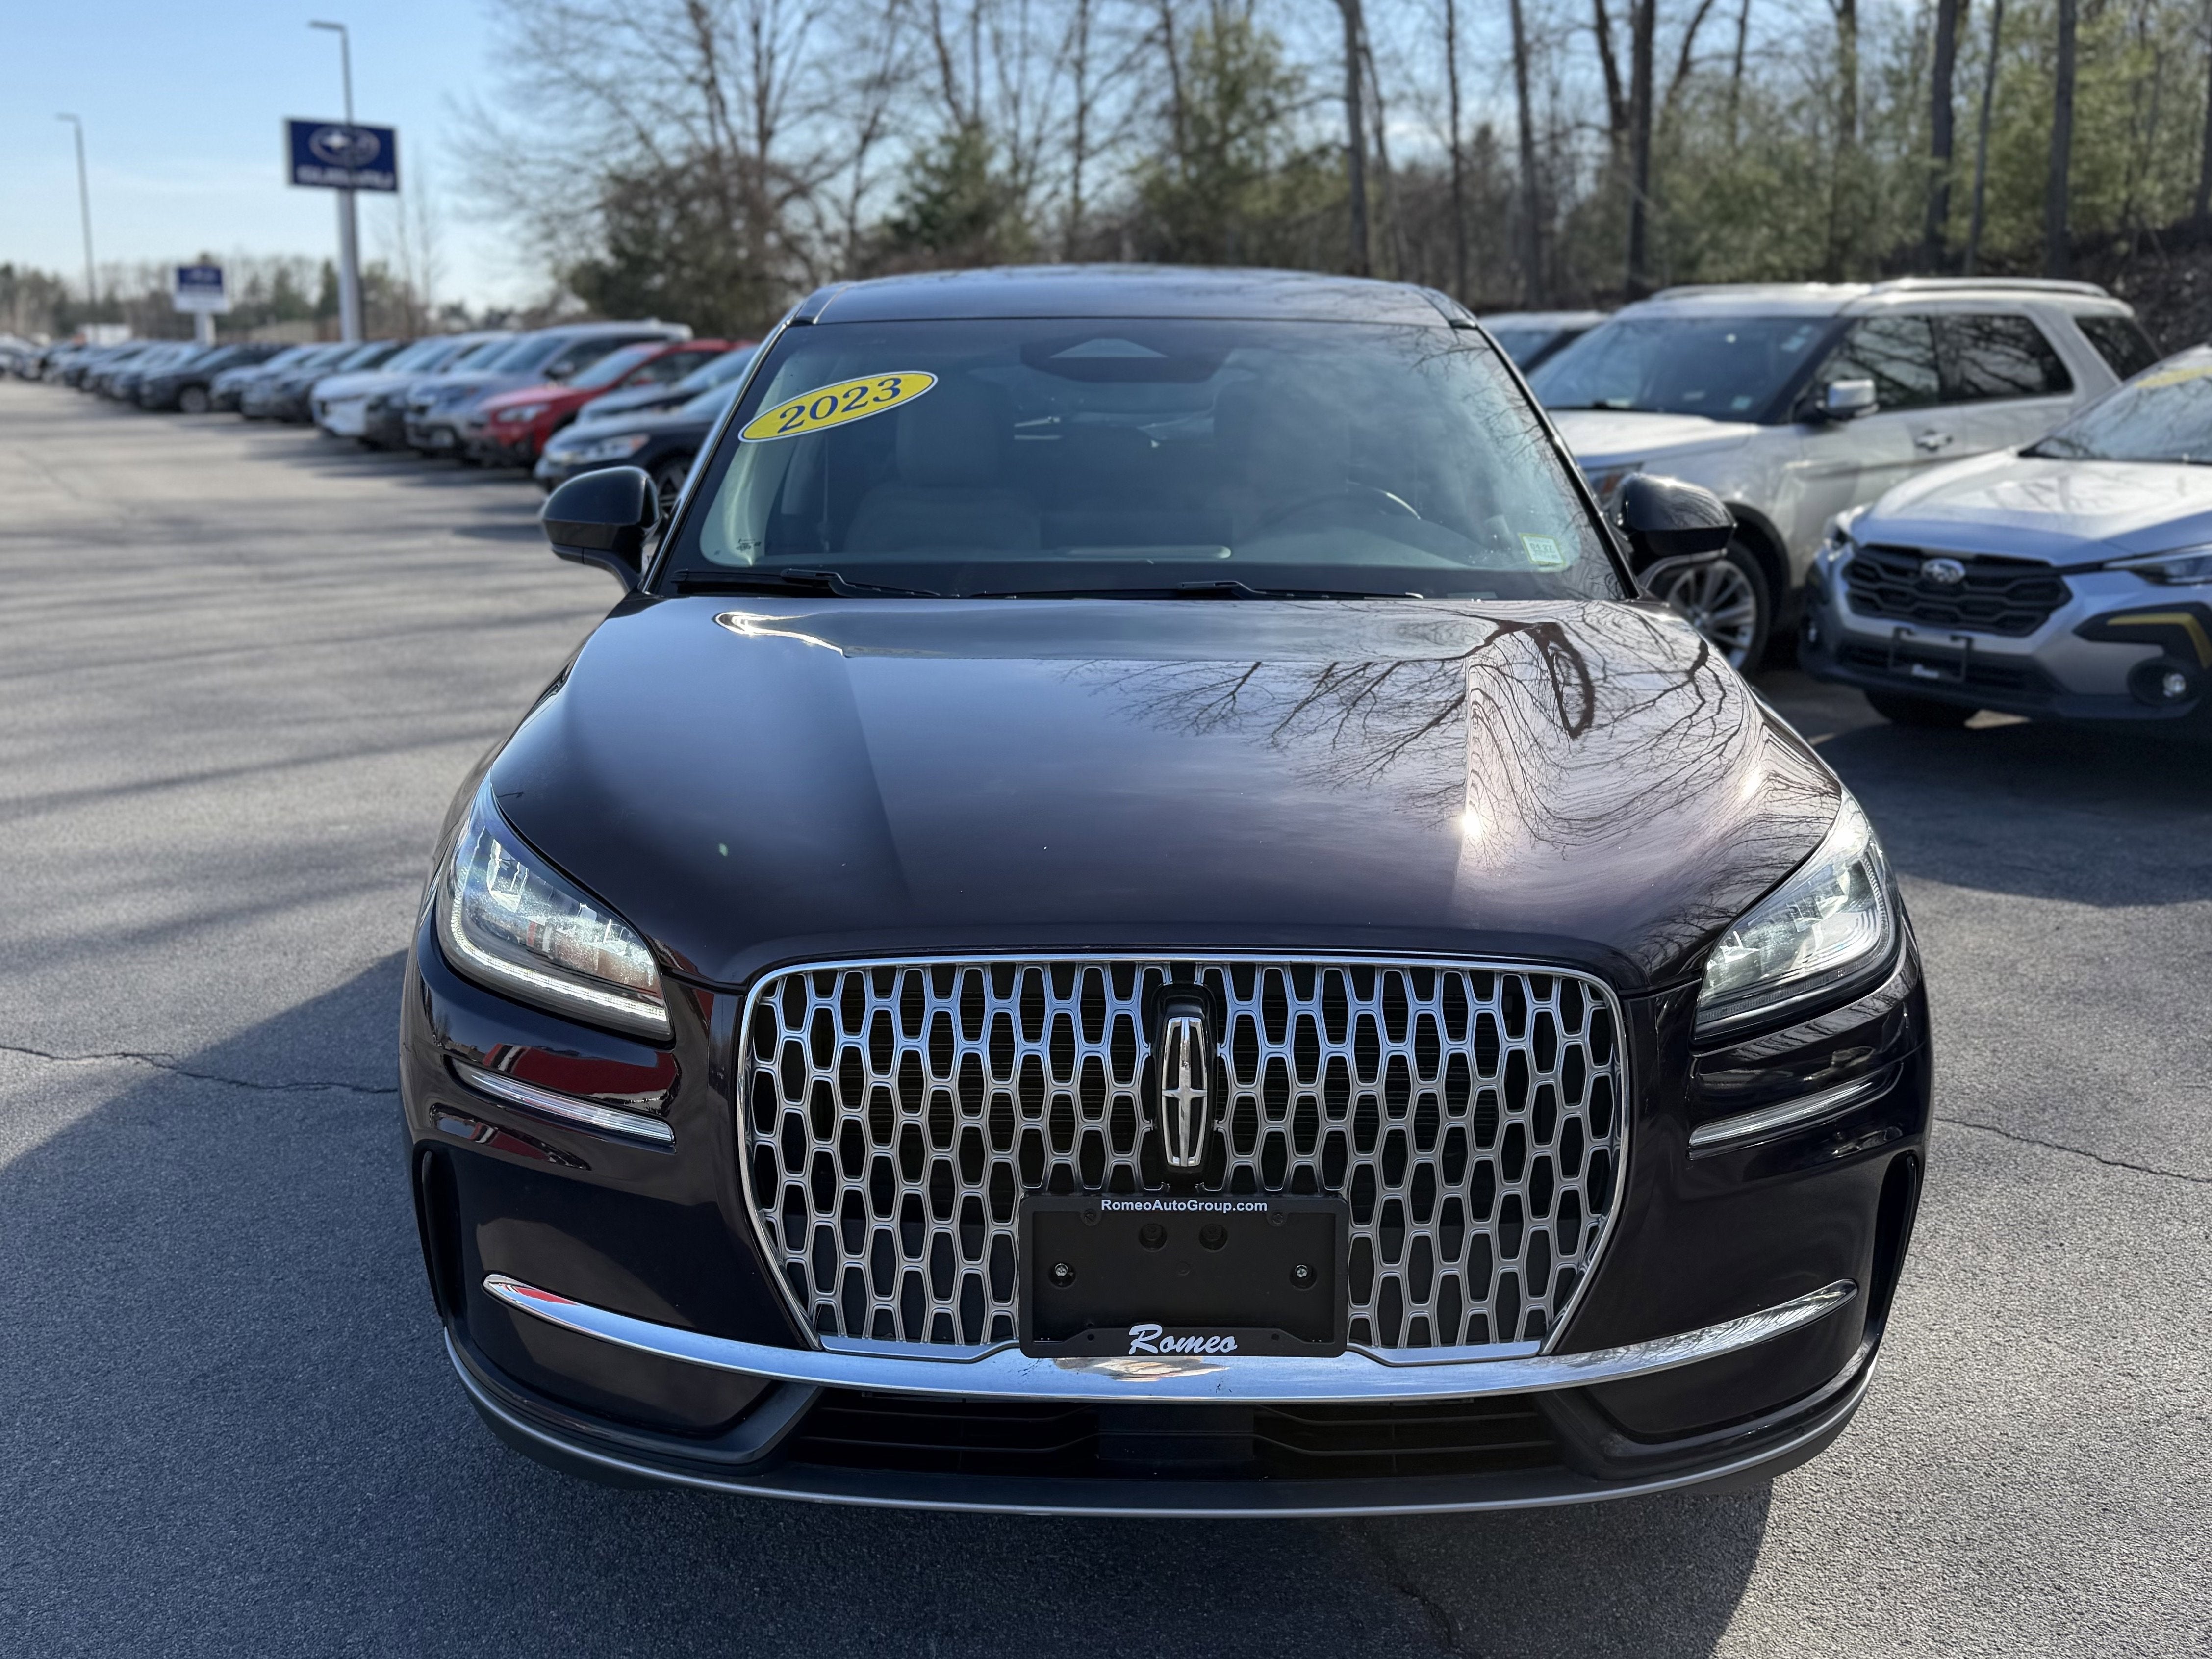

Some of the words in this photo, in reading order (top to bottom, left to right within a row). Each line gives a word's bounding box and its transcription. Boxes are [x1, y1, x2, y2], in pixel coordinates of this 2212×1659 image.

[777, 378, 902, 434] 2023
[1101, 1199, 1268, 1213] RomeoAutoGroup.com
[1128, 1324, 1238, 1355] Romeo
